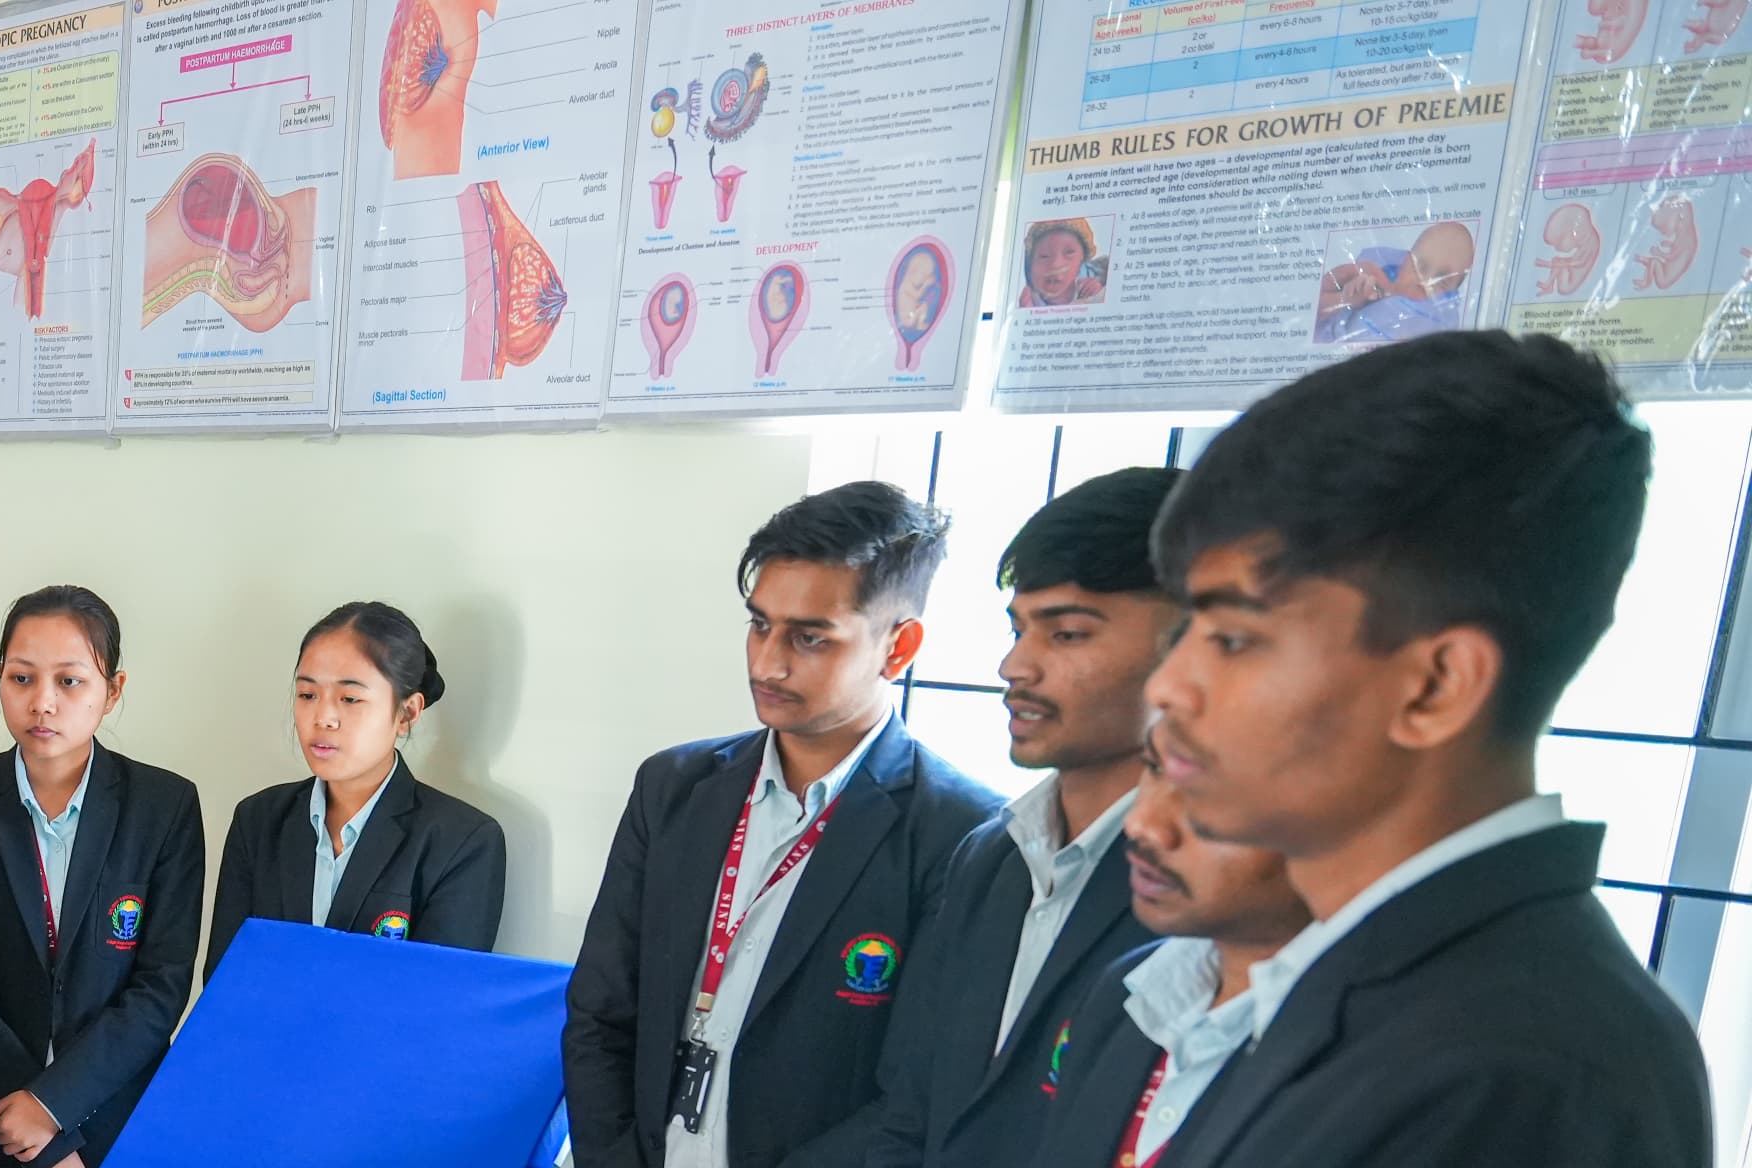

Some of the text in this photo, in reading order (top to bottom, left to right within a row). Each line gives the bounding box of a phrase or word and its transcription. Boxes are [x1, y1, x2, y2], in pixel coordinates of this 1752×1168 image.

[1269, 0, 1315, 12] Frequency
[143, 32, 160, 42] called
[161, 25, 194, 40] postpartum
[194, 16, 234, 31] haemorrhage.
[237, 13, 251, 22] Loss
[252, 10, 260, 18] of
[260, 6, 278, 16] blood
[287, 1, 308, 13] greater
[146, 0, 250, 30] Excess bleeding following childbirth
[725, 0, 916, 38] THREE DISTINCT LAYERS OF MEMBRANES
[21, 15, 87, 42] PREGNANCY
[155, 44, 168, 53] after
[174, 38, 194, 50] vaginal
[196, 34, 209, 45] birth
[211, 32, 222, 41] and
[238, 26, 246, 34] ml
[248, 22, 261, 33] after
[268, 18, 296, 30] cesarean
[298, 11, 322, 23] section.
[597, 26, 620, 40] Nipple
[186, 40, 286, 69] POSTPARTUM HAEMORRHAGE
[594, 60, 618, 71] Areola
[1358, 77, 1377, 88] feeds
[1378, 76, 1400, 88] only
[568, 88, 616, 104] Alveolar duct
[294, 103, 320, 116] Late PPH
[282, 120, 292, 129] (24
[310, 112, 332, 124] weeks)
[1029, 92, 1507, 166] THUMB RULES FOR GROWTH OF PREEMIE
[148, 128, 174, 140] Early PPH
[160, 140, 166, 148] 24
[477, 136, 552, 160] (Anterior View)
[1075, 170, 1108, 182] preemie
[1110, 166, 1134, 176] infant
[1137, 164, 1151, 173] will
[1154, 162, 1174, 171] have
[1194, 158, 1216, 169] ages
[1234, 146, 1303, 163] developmental
[1304, 146, 1322, 156] age
[1325, 139, 1379, 156] (calculated
[1382, 136, 1405, 148] from
[1408, 135, 1425, 145] the
[1427, 133, 1446, 144] day
[578, 170, 608, 196] Alveolar glands
[366, 204, 376, 214] Rib
[549, 212, 605, 227] Lactiferous duct
[755, 241, 819, 256] DEVELOPMENT
[1620, 336, 1655, 346] mother.
[546, 373, 591, 385] Alveolar duct
[372, 388, 446, 406] (Sagittal Section)
[733, 818, 746, 852] SINS
[780, 843, 809, 874] SINS
[716, 892, 732, 930] SINS
